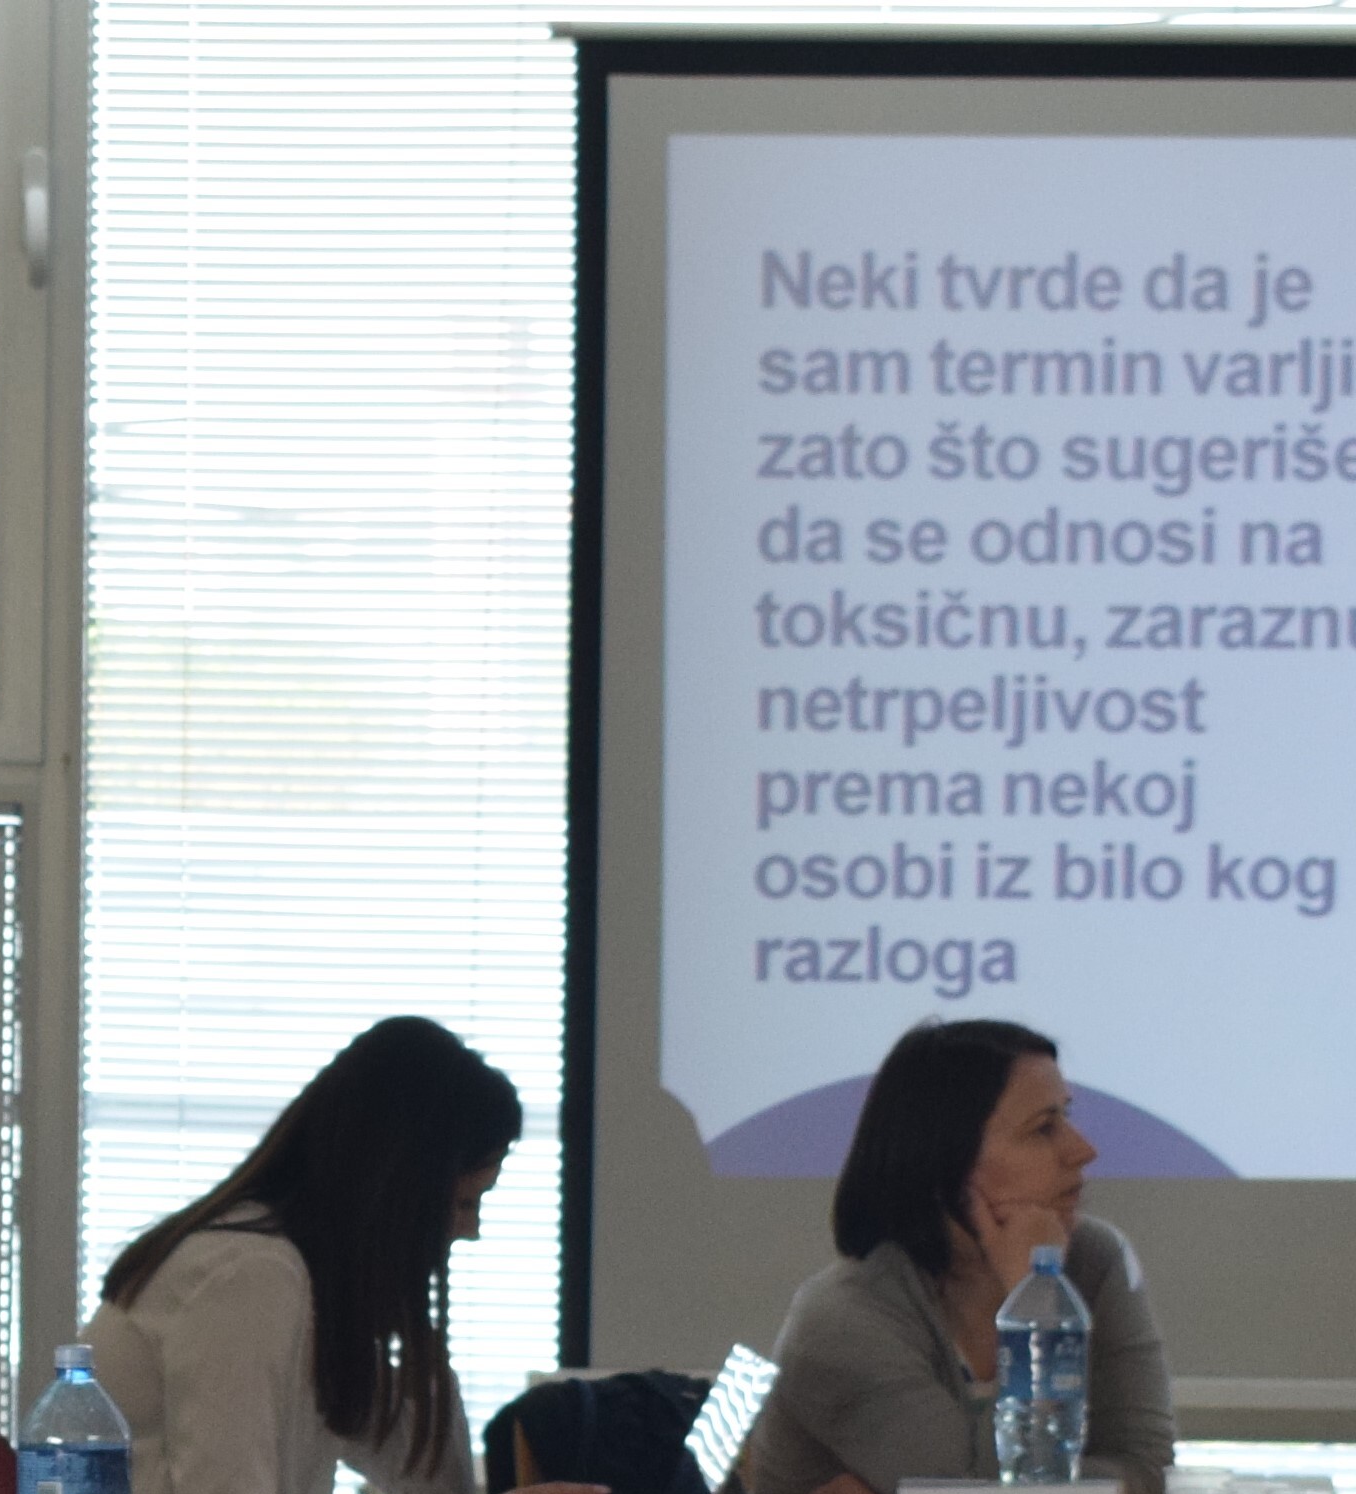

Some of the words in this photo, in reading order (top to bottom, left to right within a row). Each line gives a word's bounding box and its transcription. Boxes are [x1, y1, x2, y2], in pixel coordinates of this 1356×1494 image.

[760, 249, 919, 311] Neki
[938, 252, 1123, 311] tvrde
[1143, 253, 1229, 312] da
[1247, 252, 1314, 328] je
[758, 348, 911, 395] sam
[930, 337, 1164, 395] termin
[756, 424, 910, 480] zato
[928, 421, 1041, 481] što
[756, 505, 844, 564] da
[865, 518, 949, 565] se
[969, 506, 1217, 566] odnosi
[1240, 521, 1325, 567] na
[754, 589, 1088, 662] toksičnu,
[756, 673, 1207, 749] netrpeljivost
[755, 769, 985, 831] prema
[1003, 757, 1198, 834] nekoj
[753, 841, 955, 900] osobi
[976, 841, 1033, 900] iz
[1054, 842, 1186, 902] bilo
[1206, 842, 1338, 919] kog
[753, 924, 1018, 1001] razloga
